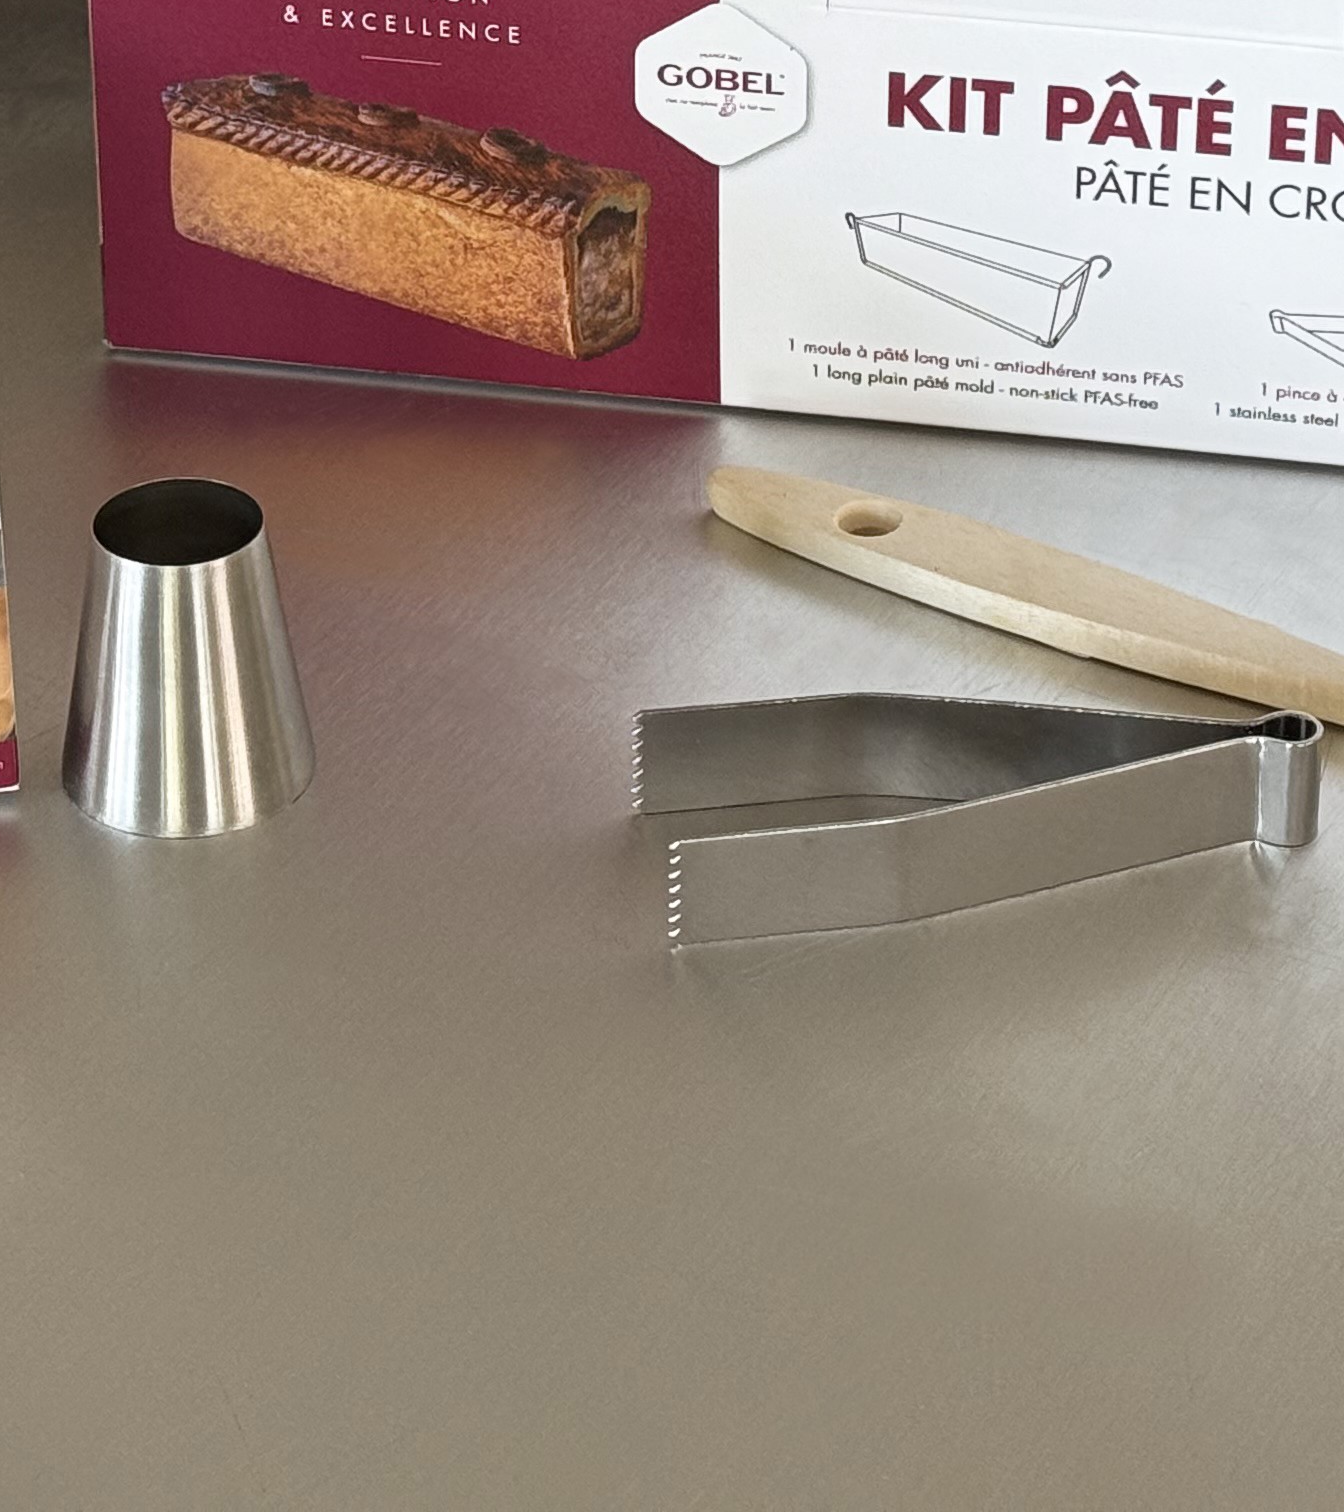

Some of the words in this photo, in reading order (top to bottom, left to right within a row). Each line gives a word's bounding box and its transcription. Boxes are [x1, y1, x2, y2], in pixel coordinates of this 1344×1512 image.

[283, 4, 299, 24] &
[322, 8, 521, 45] EXCELLENCE
[657, 63, 785, 96] GOBEL
[886, 71, 1015, 138] KIT
[1044, 69, 1235, 158] PÂTÉ
[1074, 159, 1171, 209] PÂTÉ
[1191, 178, 1253, 217] EN
[788, 337, 795, 353] 1
[803, 341, 852, 358] moule
[856, 344, 868, 360] à
[873, 347, 910, 365] pâté
[914, 348, 950, 369] long
[955, 355, 980, 371] uni
[994, 357, 1097, 381] antiadhérent
[1102, 372, 1138, 386] sans
[1143, 371, 1185, 390] PFAS
[812, 363, 819, 379] 1
[827, 364, 862, 386] long
[868, 369, 908, 395] plain
[913, 376, 950, 394] pâté
[955, 378, 995, 396] mold
[1009, 383, 1079, 405] non-stick
[1083, 390, 1159, 411] PFAS-free
[1260, 382, 1268, 397] 1
[1275, 385, 1321, 402] pince
[1326, 389, 1338, 403] à
[1214, 402, 1221, 416] 1
[1229, 406, 1298, 424] stainless
[1302, 413, 1339, 428] steel
